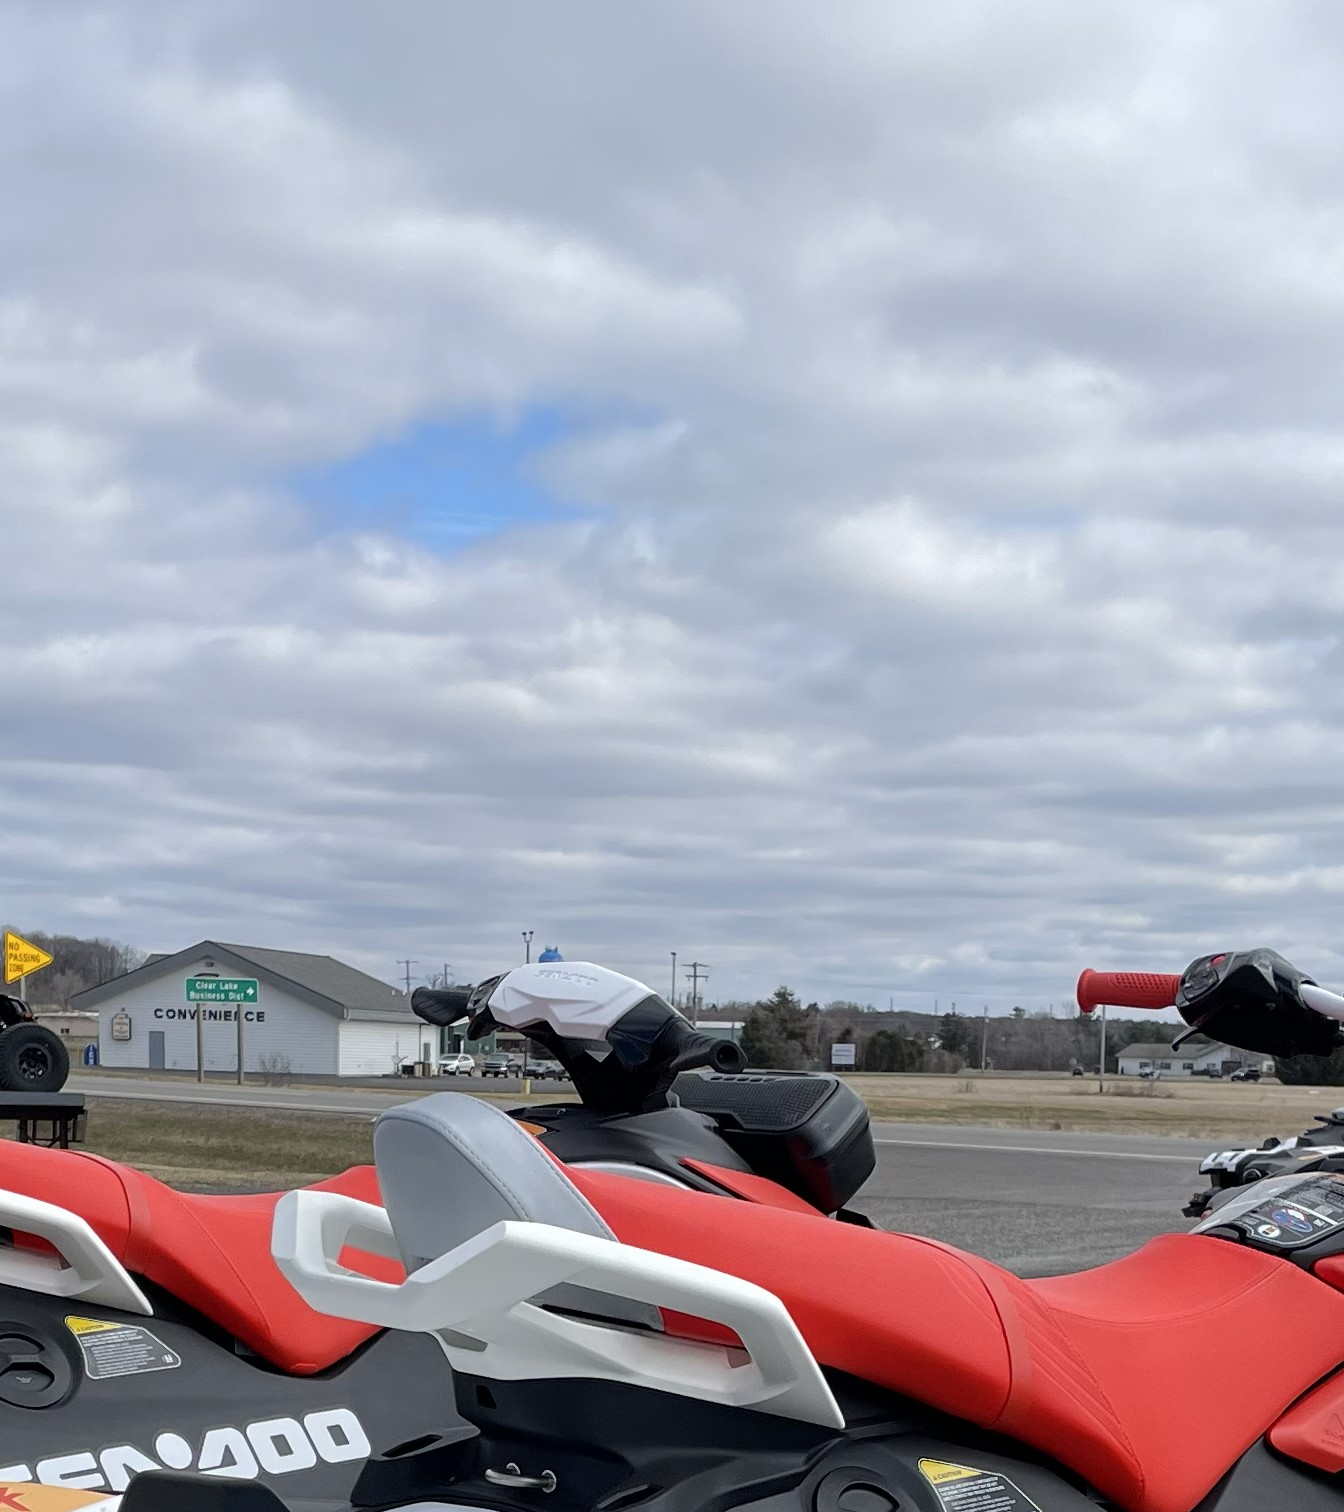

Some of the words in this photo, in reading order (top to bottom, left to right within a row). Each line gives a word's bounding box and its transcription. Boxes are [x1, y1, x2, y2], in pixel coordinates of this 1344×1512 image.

[9, 942, 20, 951] NO
[9, 952, 40, 963] PASSING
[196, 981, 216, 990] Clear
[219, 981, 238, 990] Lake
